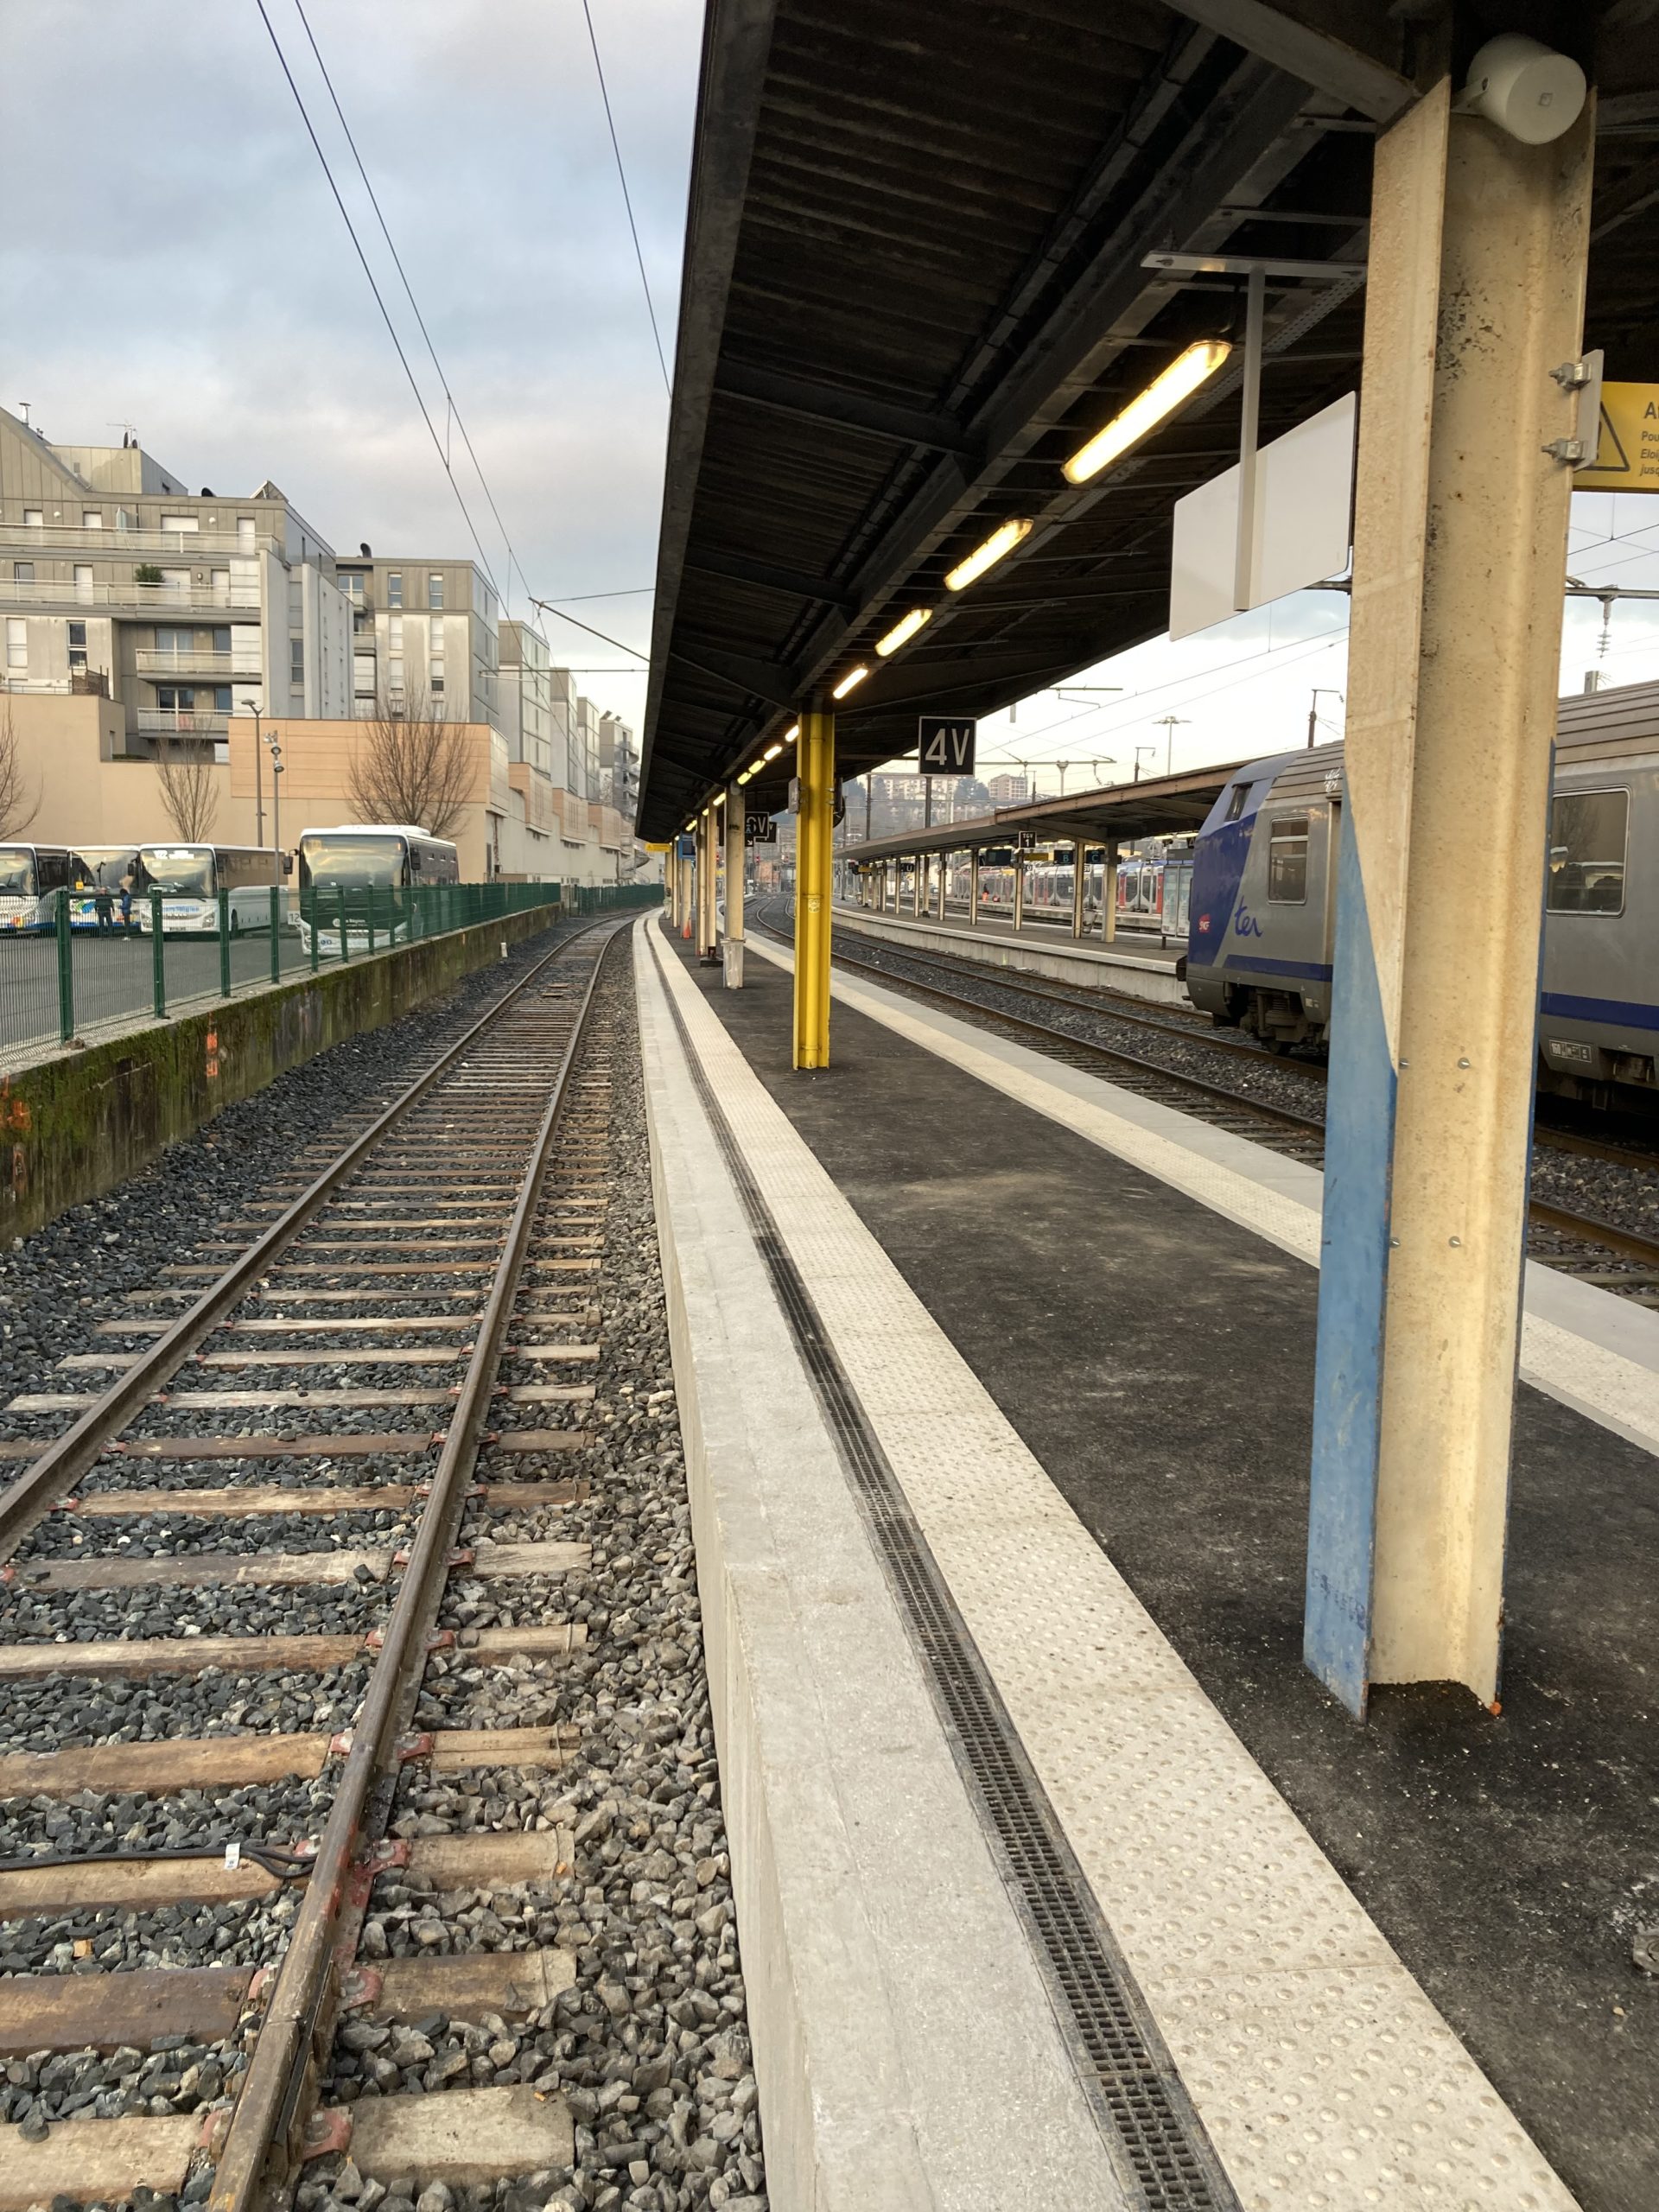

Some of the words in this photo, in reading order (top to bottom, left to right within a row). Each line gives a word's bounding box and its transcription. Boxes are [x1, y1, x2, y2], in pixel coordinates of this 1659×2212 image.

[925, 728, 970, 766] 4V
[1025, 839, 1030, 848] 1
[1063, 854, 1070, 862] B
[1091, 854, 1099, 862] C
[289, 912, 301, 923] 12
[1234, 895, 1263, 938] ter
